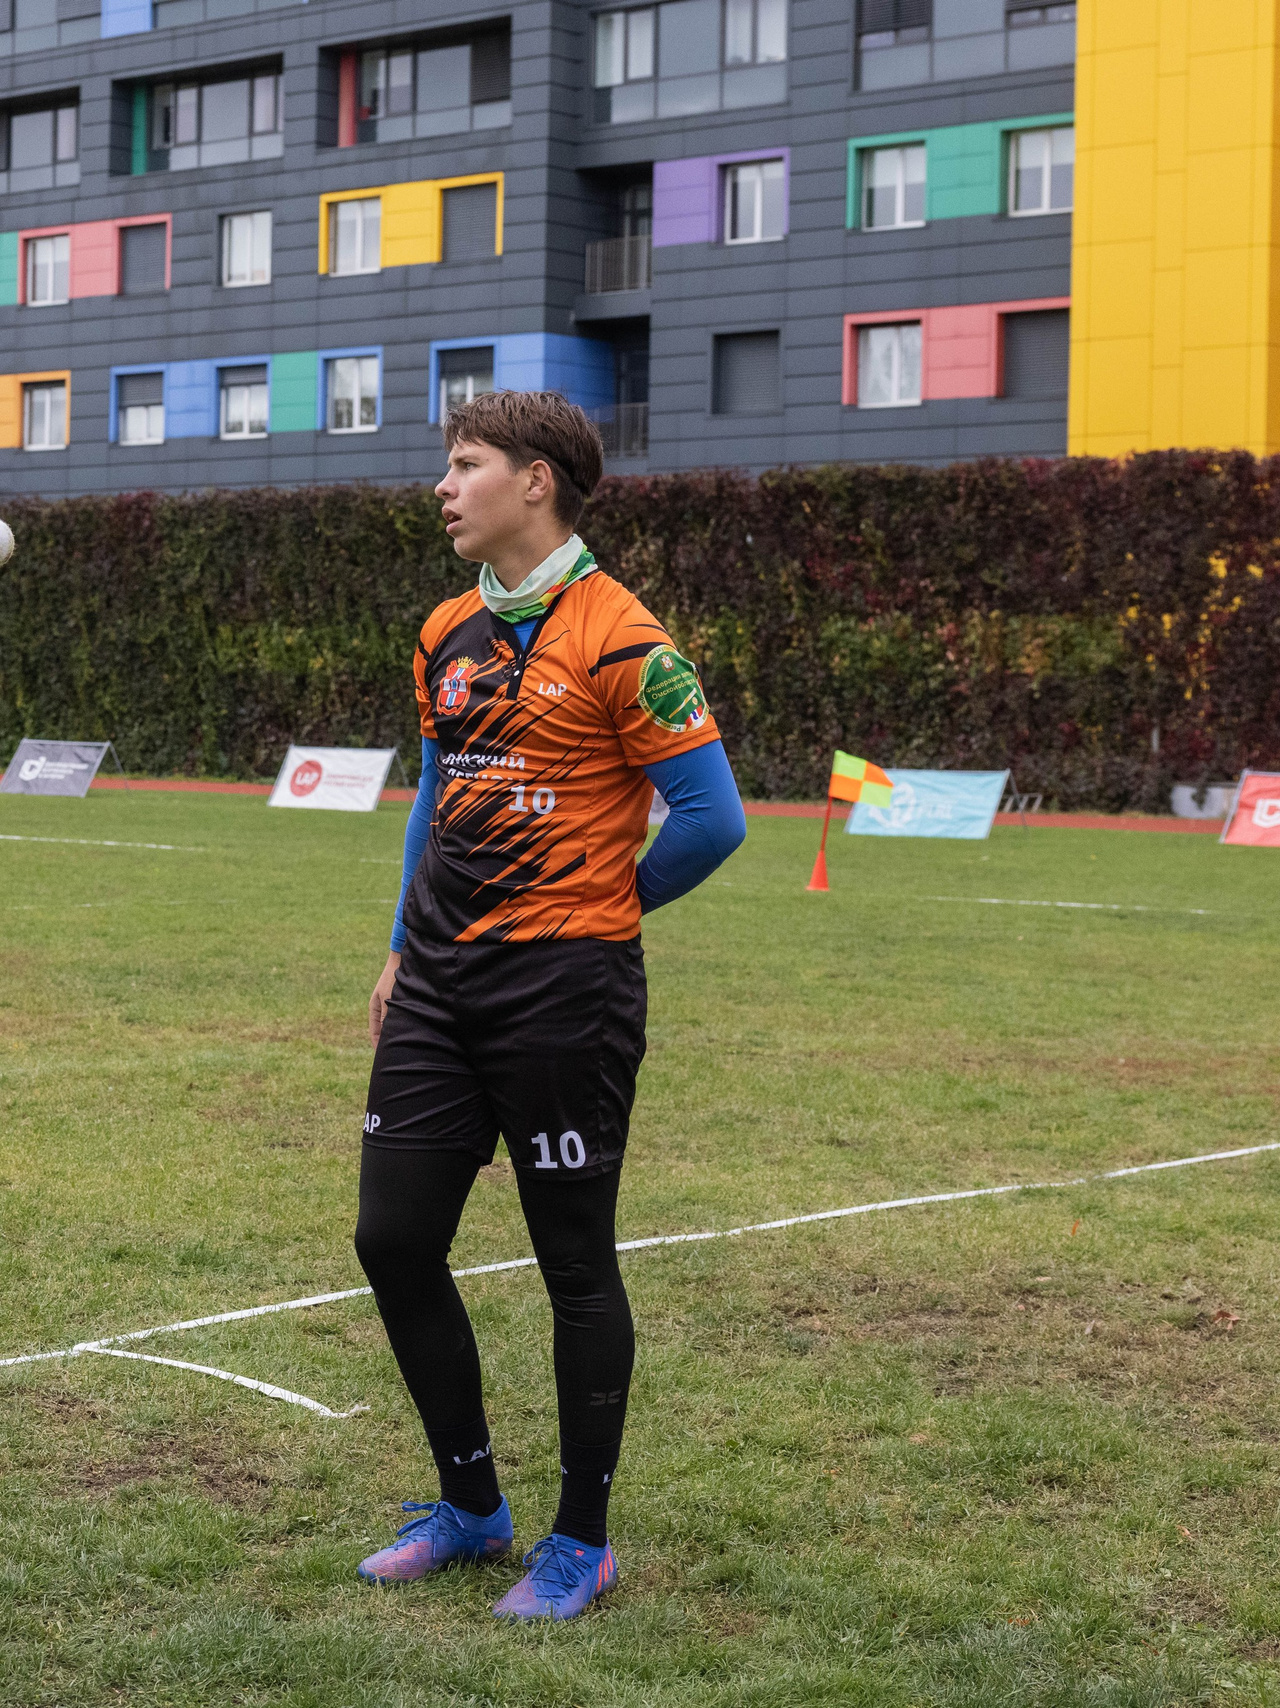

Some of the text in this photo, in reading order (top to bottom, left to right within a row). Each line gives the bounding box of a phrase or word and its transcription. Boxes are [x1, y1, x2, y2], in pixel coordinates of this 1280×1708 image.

[537, 682, 567, 697] LAP
[508, 785, 556, 815] 10
[363, 1112, 381, 1134] AP
[531, 1130, 586, 1169] 10
